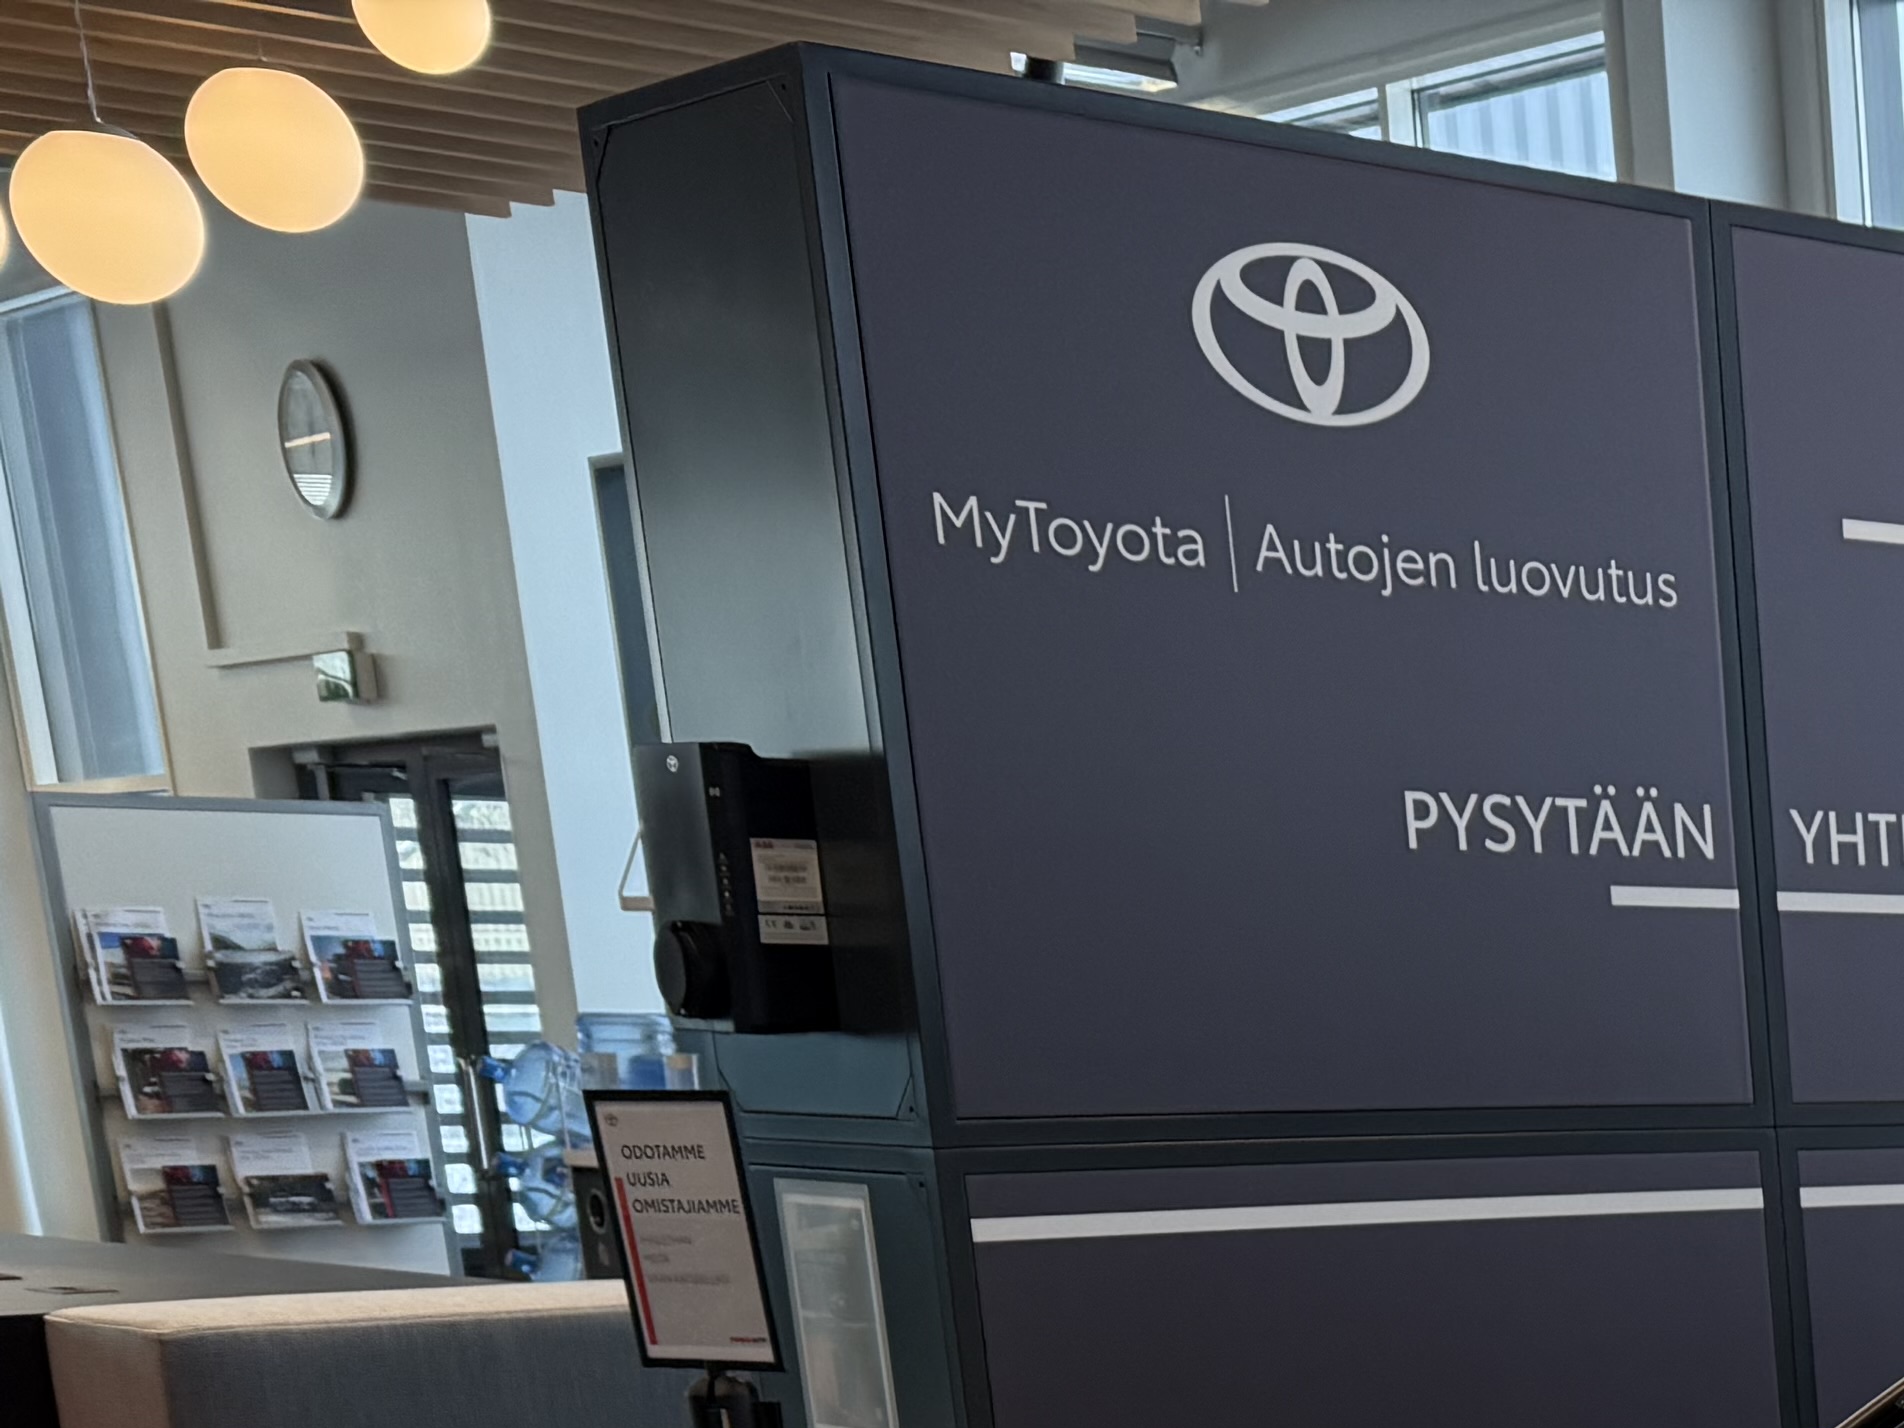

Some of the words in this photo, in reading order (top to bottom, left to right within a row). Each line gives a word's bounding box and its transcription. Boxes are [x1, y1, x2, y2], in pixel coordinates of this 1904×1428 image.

[932, 492, 1206, 571] MyToyota
[1256, 523, 1456, 597] Autojen
[1474, 540, 1678, 608] luovutus
[1403, 784, 1716, 860] PYSYTÄÄN
[621, 1145, 705, 1160] ODOTAMME
[626, 1172, 670, 1187] UUSIA
[632, 1198, 741, 1214] OMISTAJIAMME
